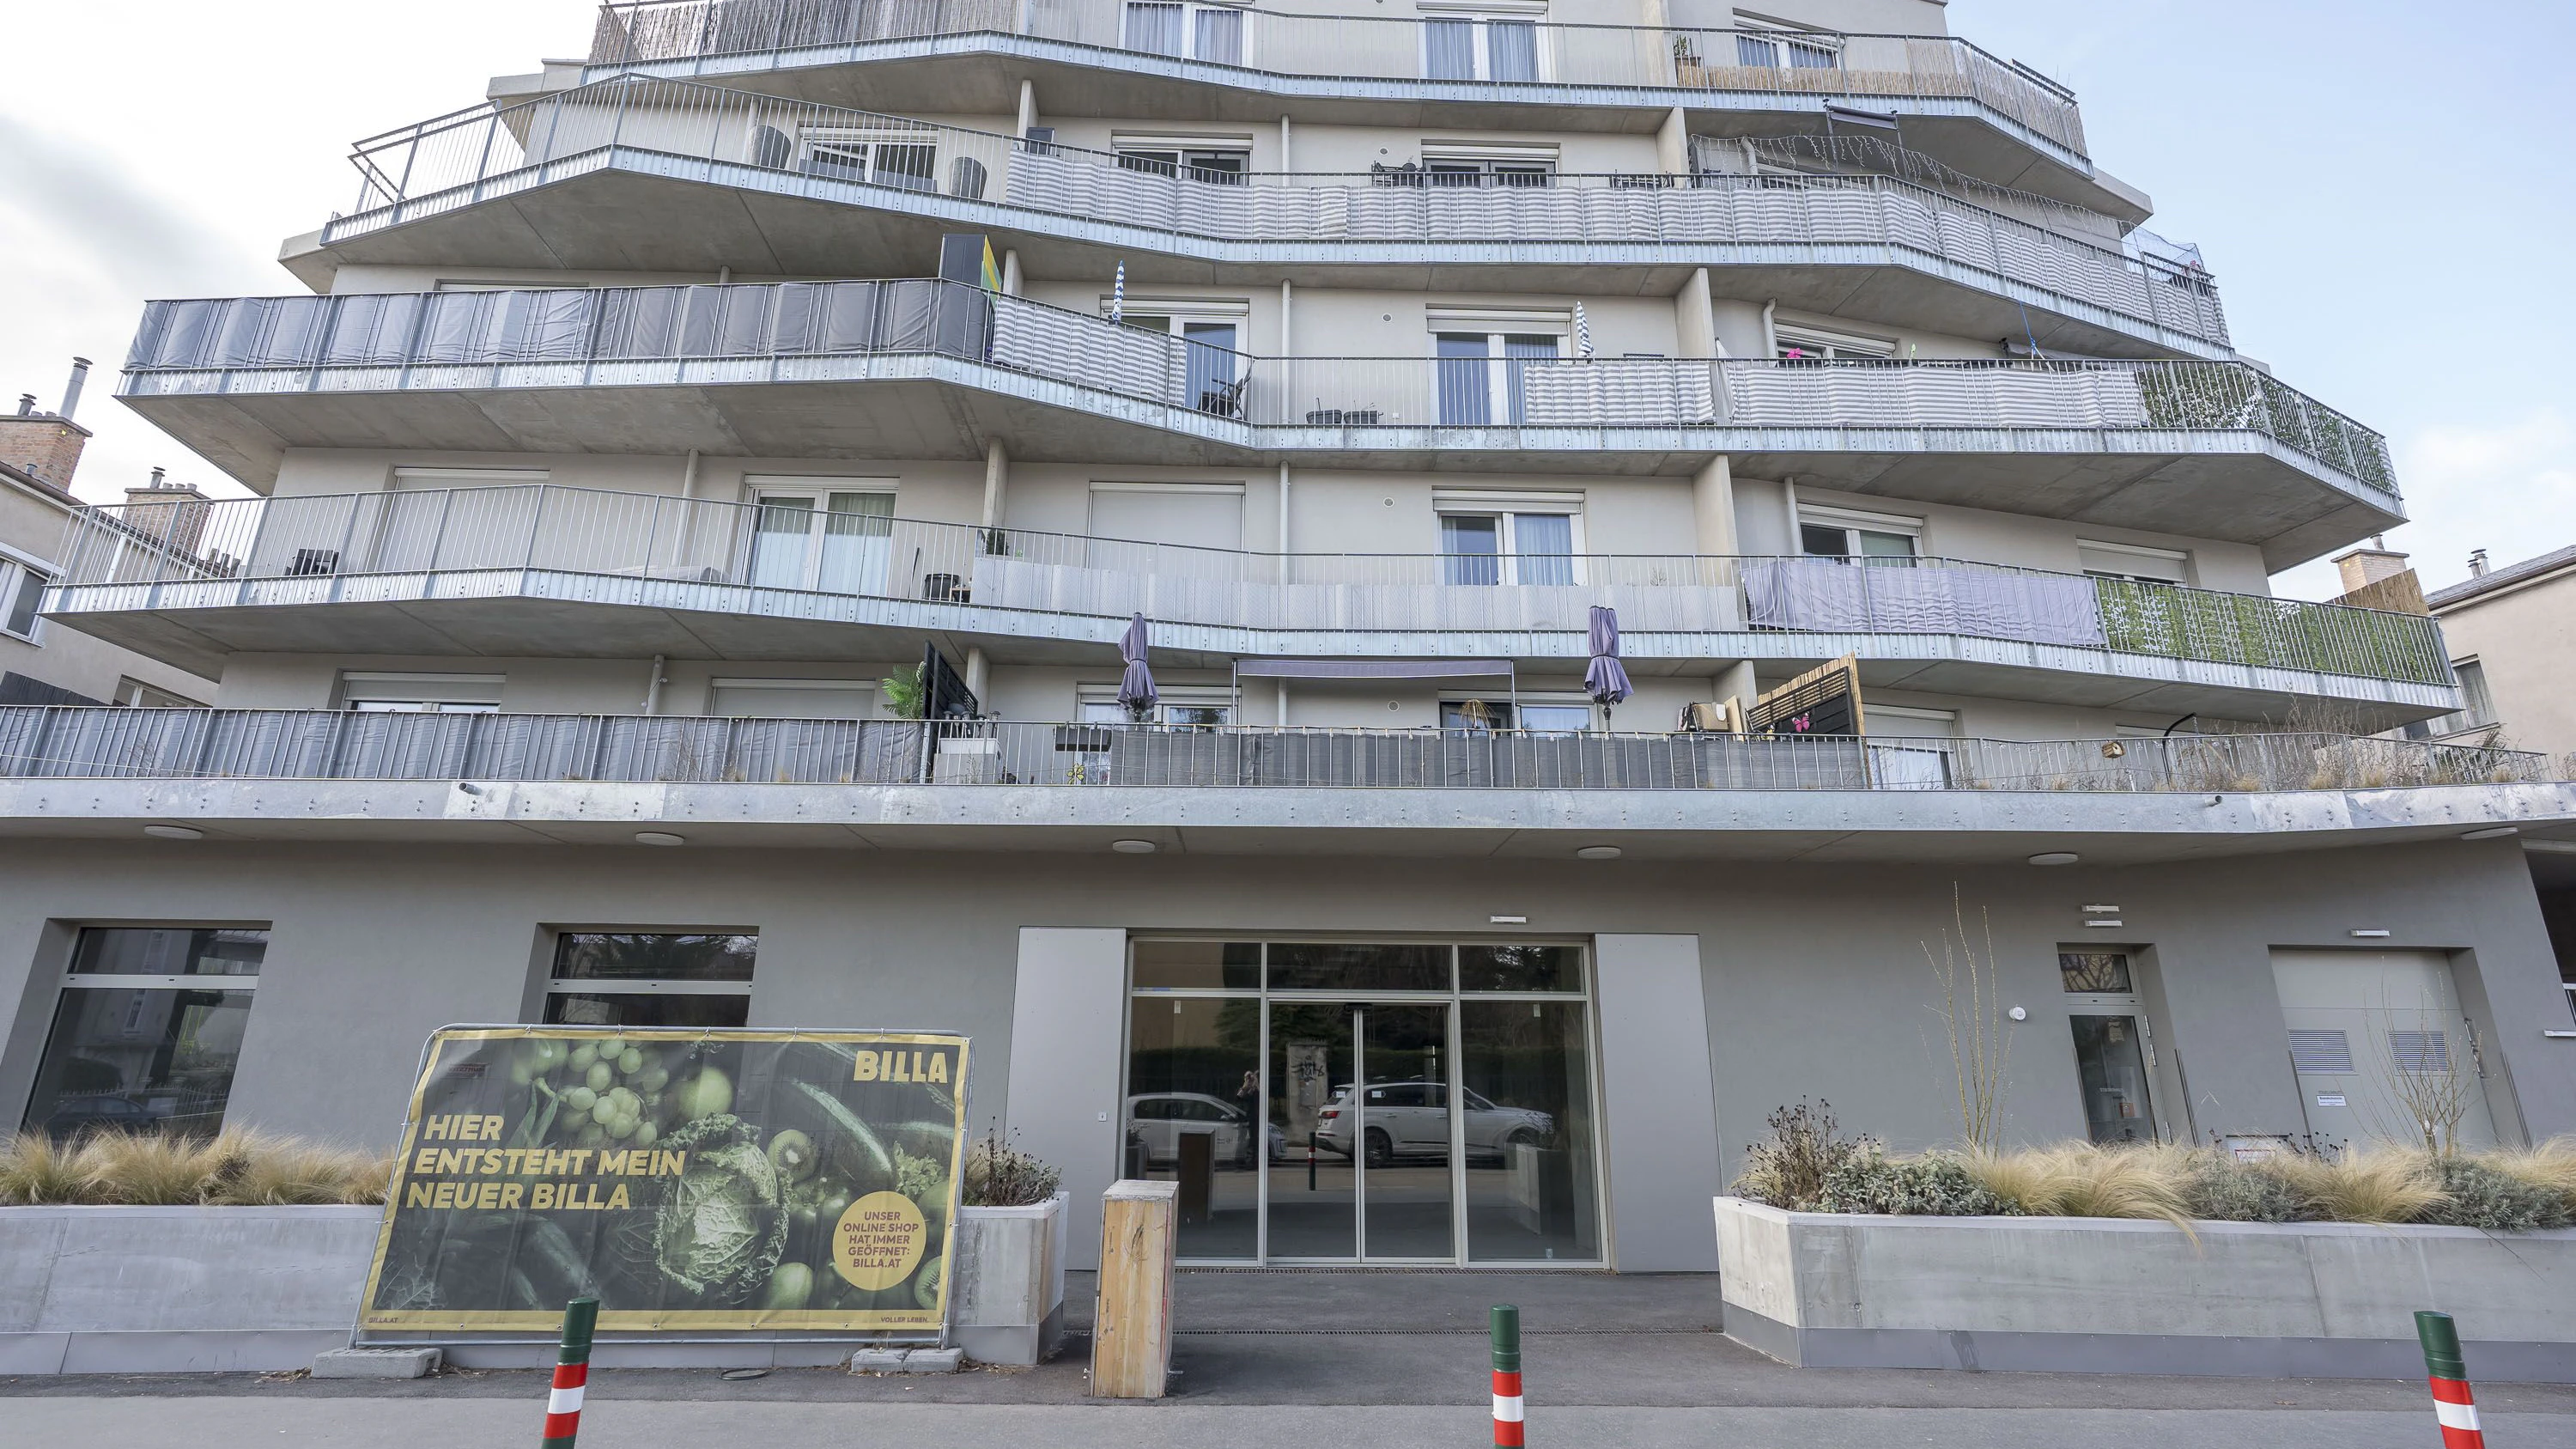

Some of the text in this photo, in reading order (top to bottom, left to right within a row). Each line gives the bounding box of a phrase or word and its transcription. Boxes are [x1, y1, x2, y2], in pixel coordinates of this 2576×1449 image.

[853, 1050, 948, 1084] BILLA
[423, 1114, 505, 1141] HIER
[413, 1148, 686, 1176] ENTSTEHT MEIN
[406, 1182, 631, 1210] NEUER BILLA
[864, 1211, 901, 1221] UNSER
[843, 1223, 919, 1233] ONLINE SHOP
[848, 1235, 910, 1244] HAT IMMER
[848, 1244, 910, 1256] GEÖFFNET:
[853, 1258, 902, 1268] BILLA.AT
